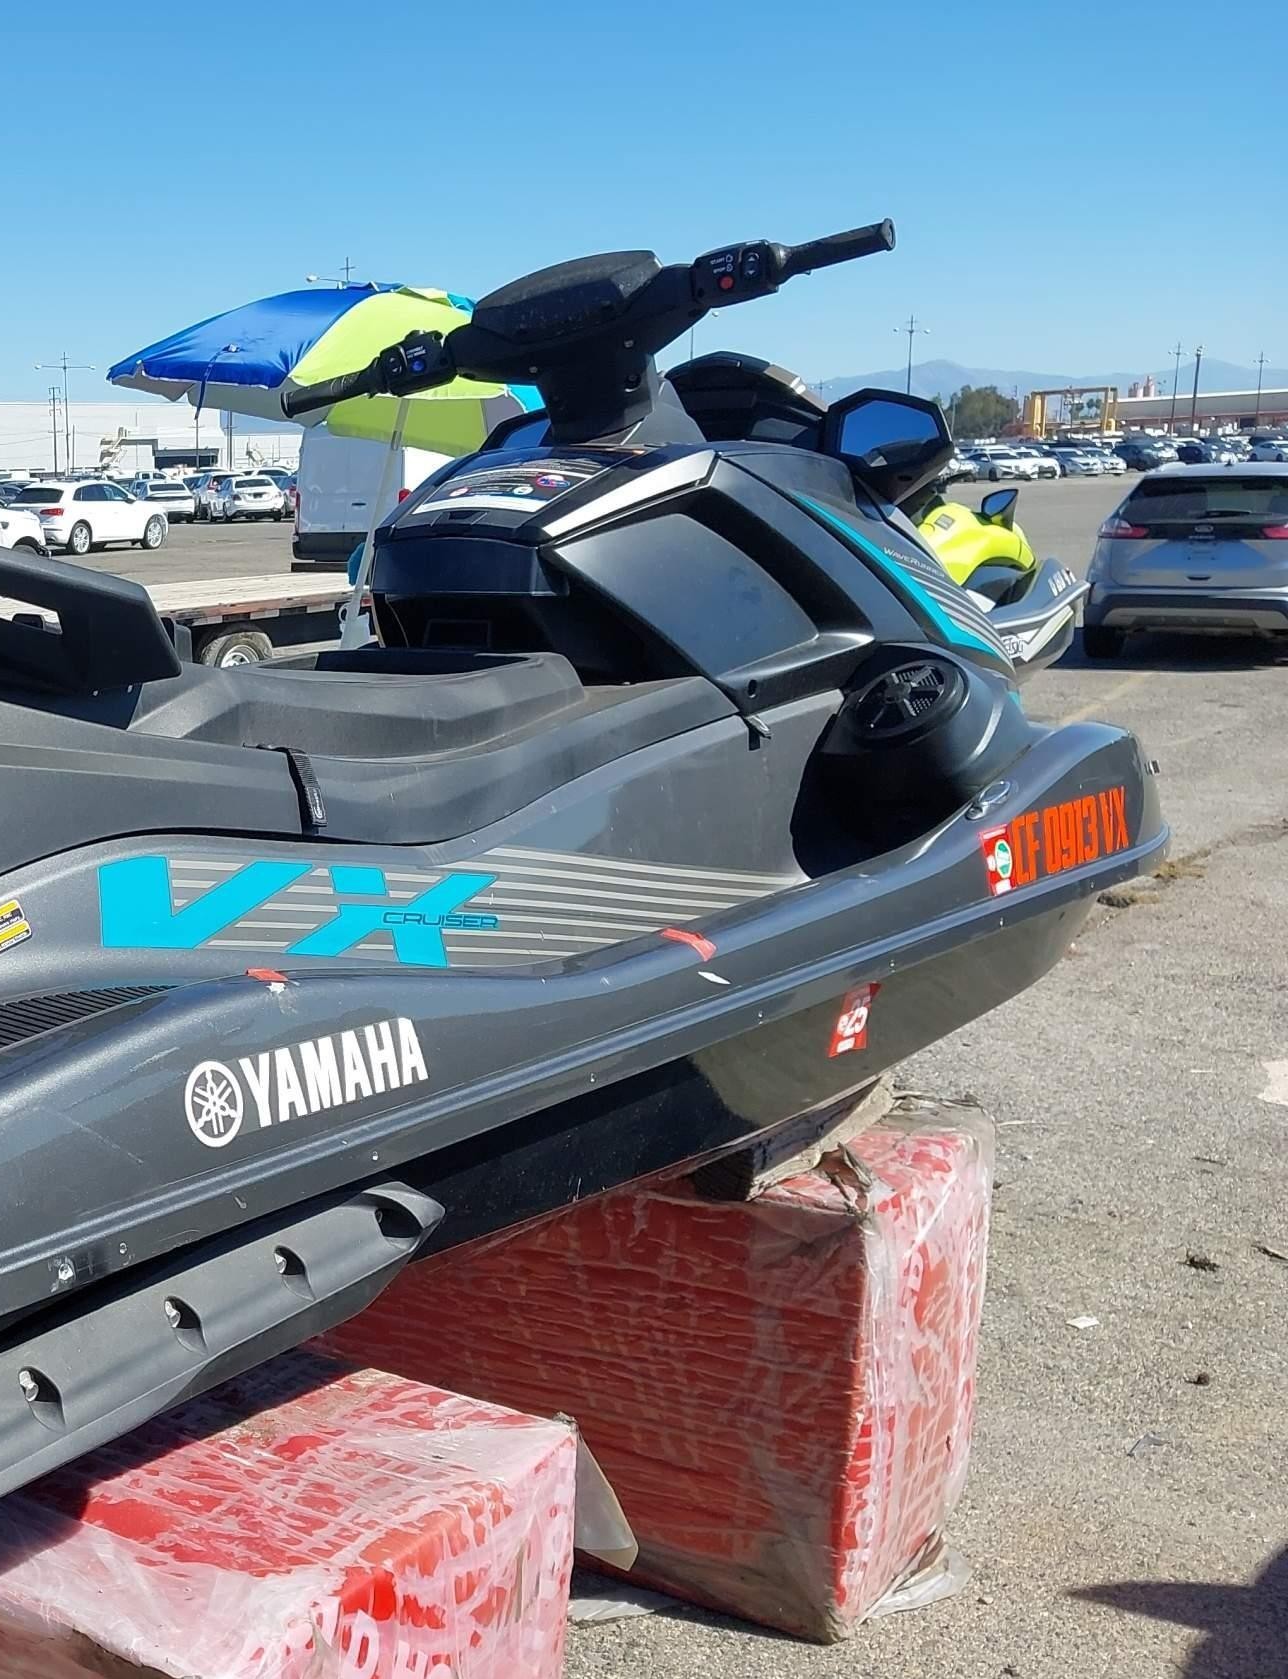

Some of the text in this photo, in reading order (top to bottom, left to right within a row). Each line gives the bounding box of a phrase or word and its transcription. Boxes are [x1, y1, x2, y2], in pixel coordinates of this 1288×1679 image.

[1012, 811, 1040, 885] CF
[1043, 795, 1099, 874] 0913
[1099, 786, 1128, 854] VX
[98, 855, 498, 968] VX
[382, 911, 499, 929] CRUISER
[239, 1017, 429, 1128] YAMAHA
